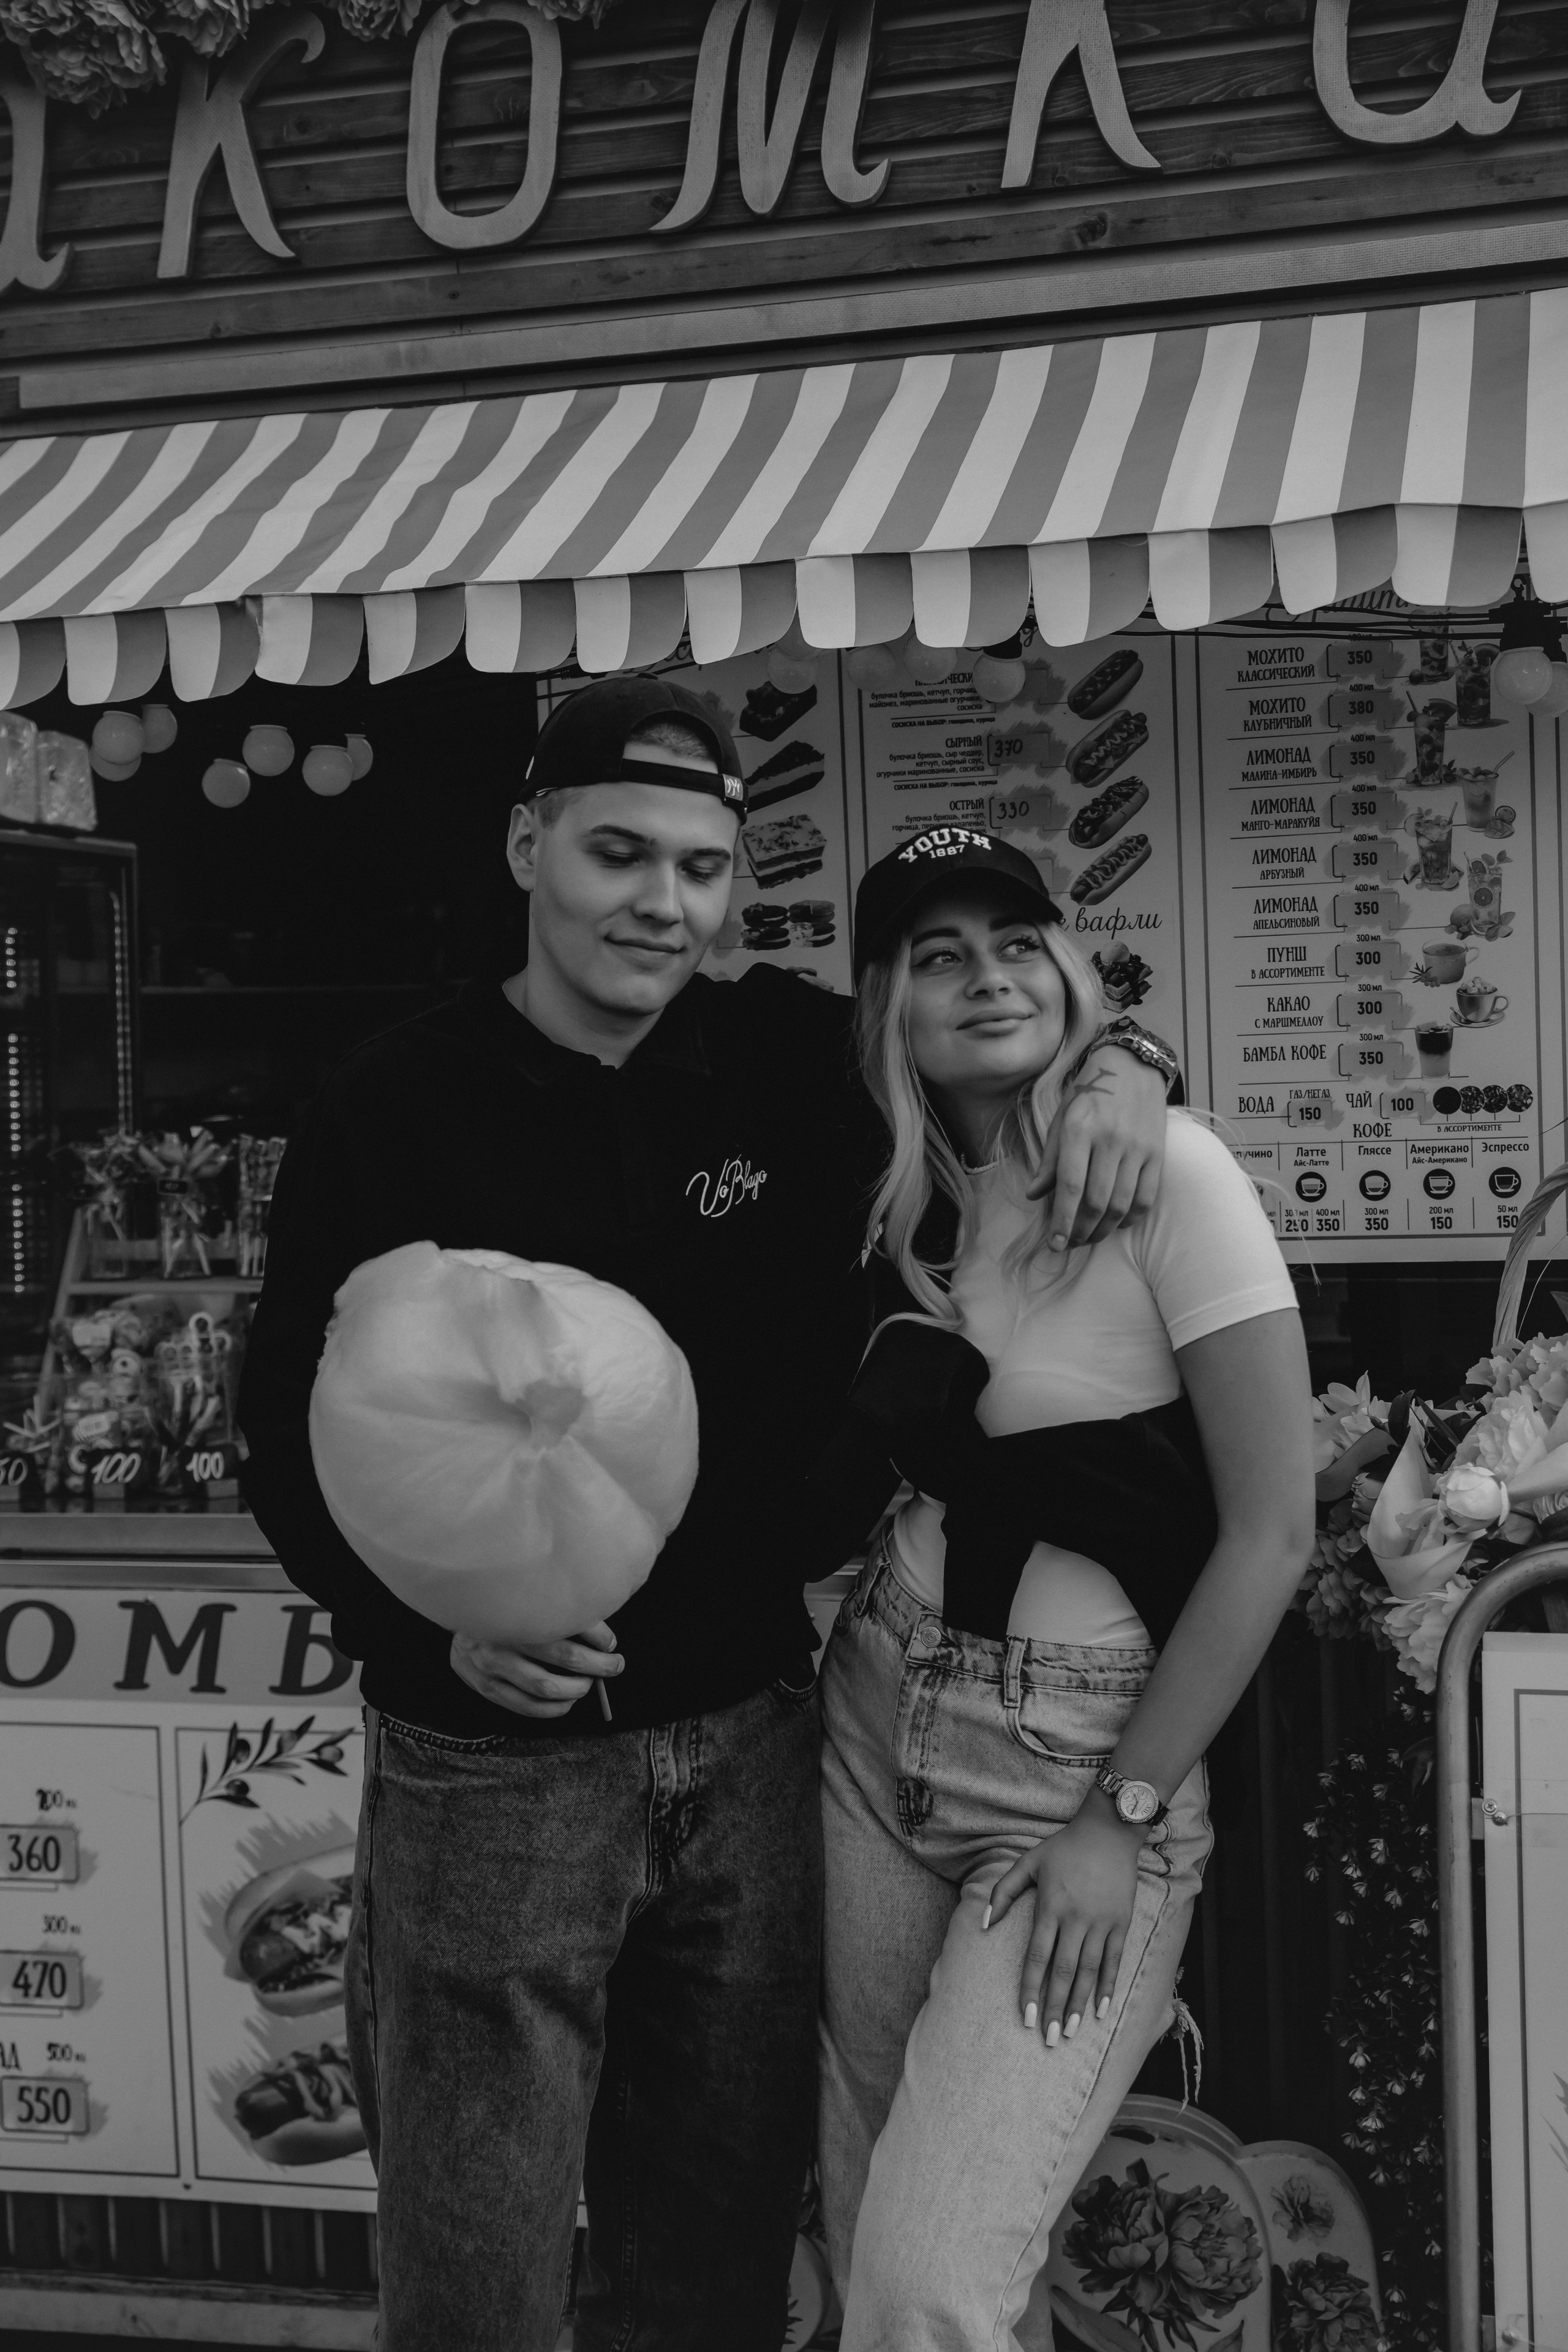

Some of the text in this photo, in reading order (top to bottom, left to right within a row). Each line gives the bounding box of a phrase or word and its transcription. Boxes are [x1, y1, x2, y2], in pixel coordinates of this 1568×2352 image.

[1247, 647, 1305, 665] МОХИТО
[1348, 650, 1373, 665] 350
[1238, 664, 1315, 682] КЛАССИЧЕСКИЙ
[927, 688, 951, 697] кетчуп,
[900, 698, 948, 707] маринованные
[1249, 697, 1306, 715] МОХИТО
[1349, 700, 1374, 715] 380
[1243, 714, 1312, 731] КЛУБНИЧНЫЙ
[945, 735, 982, 748] СЫРНЫЙ
[994, 739, 1023, 758] 370
[889, 753, 916, 761] булочка
[918, 751, 944, 760] бриошь,
[941, 758, 967, 766] сырный
[1246, 747, 1311, 766] ЛИМОНАД
[1350, 750, 1375, 765] 350
[876, 769, 906, 778] огурчики
[908, 767, 958, 776] маринованные,
[1242, 767, 1317, 782] МАЛИНА-ИМБИРЬ
[949, 798, 984, 810] ОСТРЫЙ
[997, 801, 1029, 820] 330
[1251, 796, 1315, 815] ЛИМОНАД
[1352, 801, 1376, 815] 350
[933, 813, 960, 822] бриошь,
[1241, 816, 1320, 831] МАНГО-МАРАКУЙЯ
[892, 824, 920, 832] горчица,
[898, 827, 992, 863] YOUTH
[929, 844, 965, 858] 1887
[1252, 846, 1316, 865] ЛИМОНАД
[1353, 852, 1378, 866] 350
[1260, 867, 1305, 880] АРБУЗНЫЙ
[1254, 896, 1318, 914] ЛИМОНАД
[1354, 902, 1379, 915] 350
[1076, 907, 1163, 940] вафли
[1253, 916, 1320, 930] АПЕЛЬСИНОВЫЙ
[1267, 946, 1306, 962] ПУНШ
[1355, 951, 1381, 965] 300
[1251, 967, 1325, 979] В АССОРТИМЕНТЕ
[1267, 996, 1310, 1012] КАКАО
[1357, 1001, 1382, 1015] 300
[1254, 1016, 1324, 1028] С МАРШМЕЛЛОУ
[1243, 1044, 1327, 1062] БАМБЛ КОФЕ
[1359, 1052, 1384, 1065] 350
[1238, 1096, 1275, 1115] ВОДА
[1346, 1091, 1372, 1108] ЧАЙ
[1390, 1098, 1414, 1111] 100
[1299, 1107, 1321, 1120] 150
[1353, 1123, 1392, 1138] КОФЕ
[1444, 1124, 1502, 1133] АССОРТИМЕНТЕ
[1296, 1147, 1326, 1157] Латте
[1359, 1145, 1392, 1155] Гляссе
[1410, 1144, 1469, 1156] Американо
[1482, 1142, 1529, 1155] Эспрессо
[1317, 1218, 1340, 1232] 350
[1365, 1218, 1389, 1231] 350
[1431, 1216, 1452, 1229] 150
[1496, 1215, 1518, 1229] 150
[91, 1452, 141, 1484] 100
[186, 1452, 225, 1482] 100
[8, 1834, 60, 1872] 360
[12, 1961, 66, 1998] 470
[17, 2086, 71, 2124] 550
